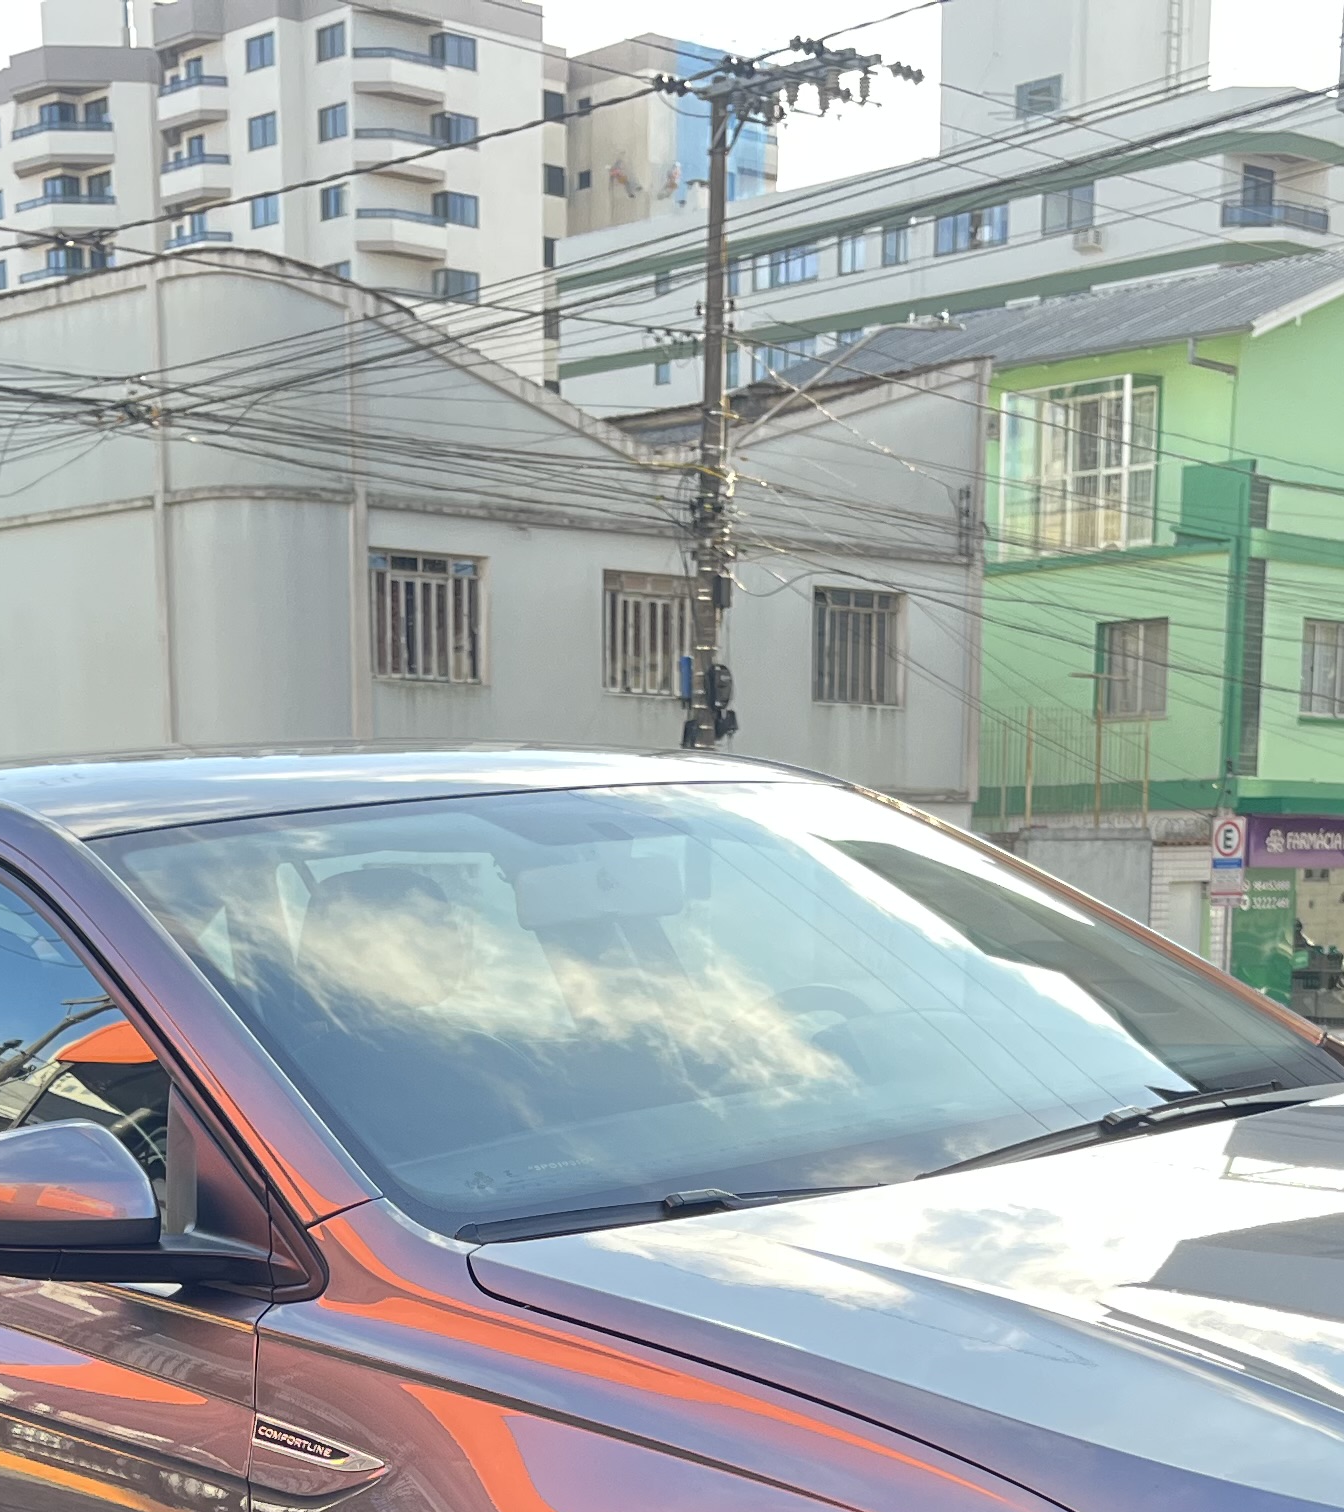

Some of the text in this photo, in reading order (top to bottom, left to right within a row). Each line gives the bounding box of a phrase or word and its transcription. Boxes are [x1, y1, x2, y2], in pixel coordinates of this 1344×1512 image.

[1223, 828, 1233, 850] E
[1286, 828, 1342, 851] FARMÁCIA
[257, 1425, 333, 1458] COMFORTLINE
